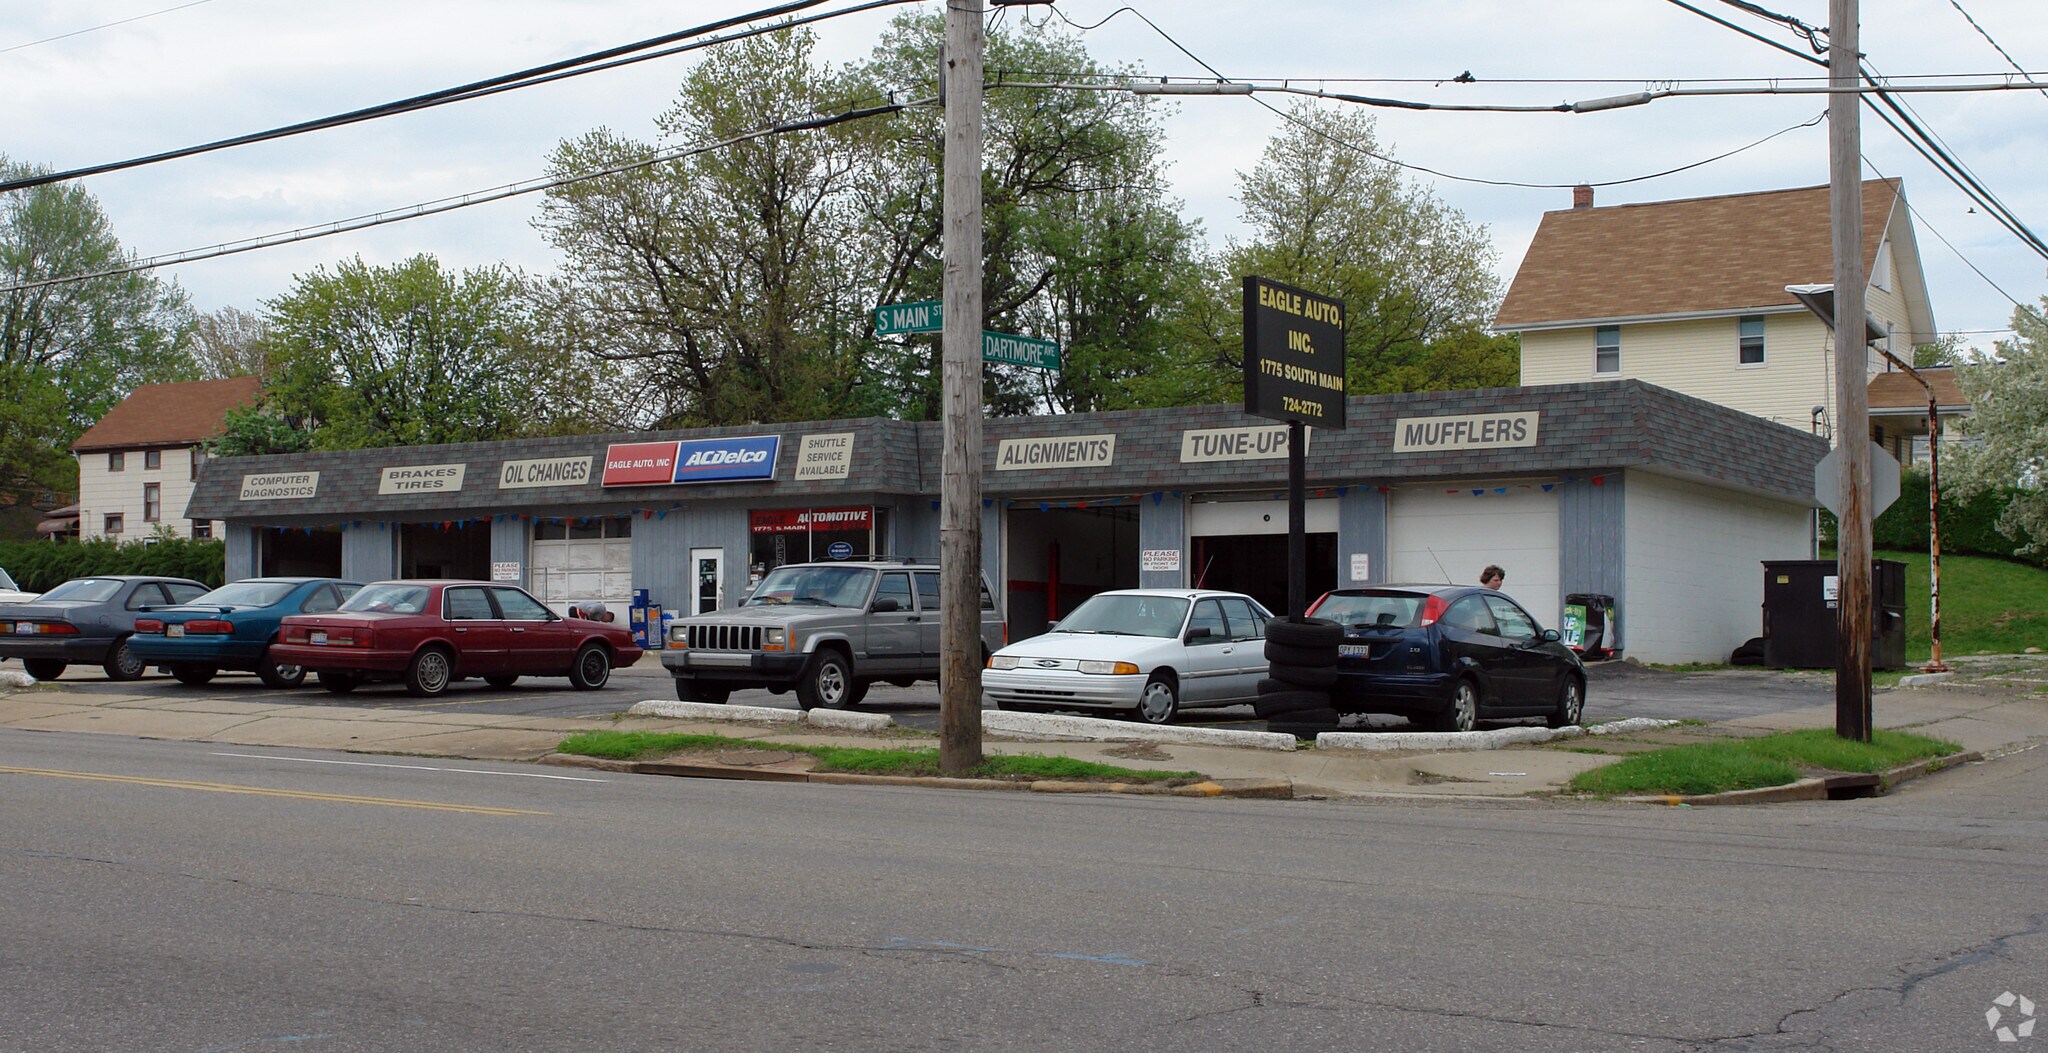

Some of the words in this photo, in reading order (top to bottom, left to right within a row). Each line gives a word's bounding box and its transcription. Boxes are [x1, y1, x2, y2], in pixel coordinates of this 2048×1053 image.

[1260, 285, 1301, 316] EAGLE
[1304, 299, 1342, 330] AUTO,
[878, 312, 888, 331] S
[893, 306, 929, 330] MAIN
[986, 335, 1044, 365] DARTMORE
[1044, 346, 1055, 358] AVE
[1288, 330, 1314, 354] INC.
[1260, 358, 1282, 378] 1775
[1285, 364, 1317, 386] SOUTH
[1319, 373, 1343, 392] MAIN
[1282, 396, 1323, 417] 724-2772
[1404, 417, 1527, 446] MUFFLERS
[808, 438, 847, 449] SHUTTLE
[1002, 439, 1109, 465] ALIGNMENTS
[1191, 431, 1290, 456] TUNE-UP
[608, 459, 632, 469] EAGLE
[633, 458, 655, 469] AUTO,
[656, 457, 670, 467] INC
[684, 448, 768, 466] ACDelco
[806, 452, 843, 462] SERVICE
[389, 468, 457, 480] BRAKES
[504, 464, 524, 484] OIL
[527, 461, 588, 483] CHANGES
[799, 465, 846, 476] AVAILABLE
[250, 475, 310, 486] COMPUTER
[395, 480, 444, 490] TIRES
[242, 486, 314, 498] DIAGNOSTICS
[797, 510, 869, 524] AUTOMOTIVE
